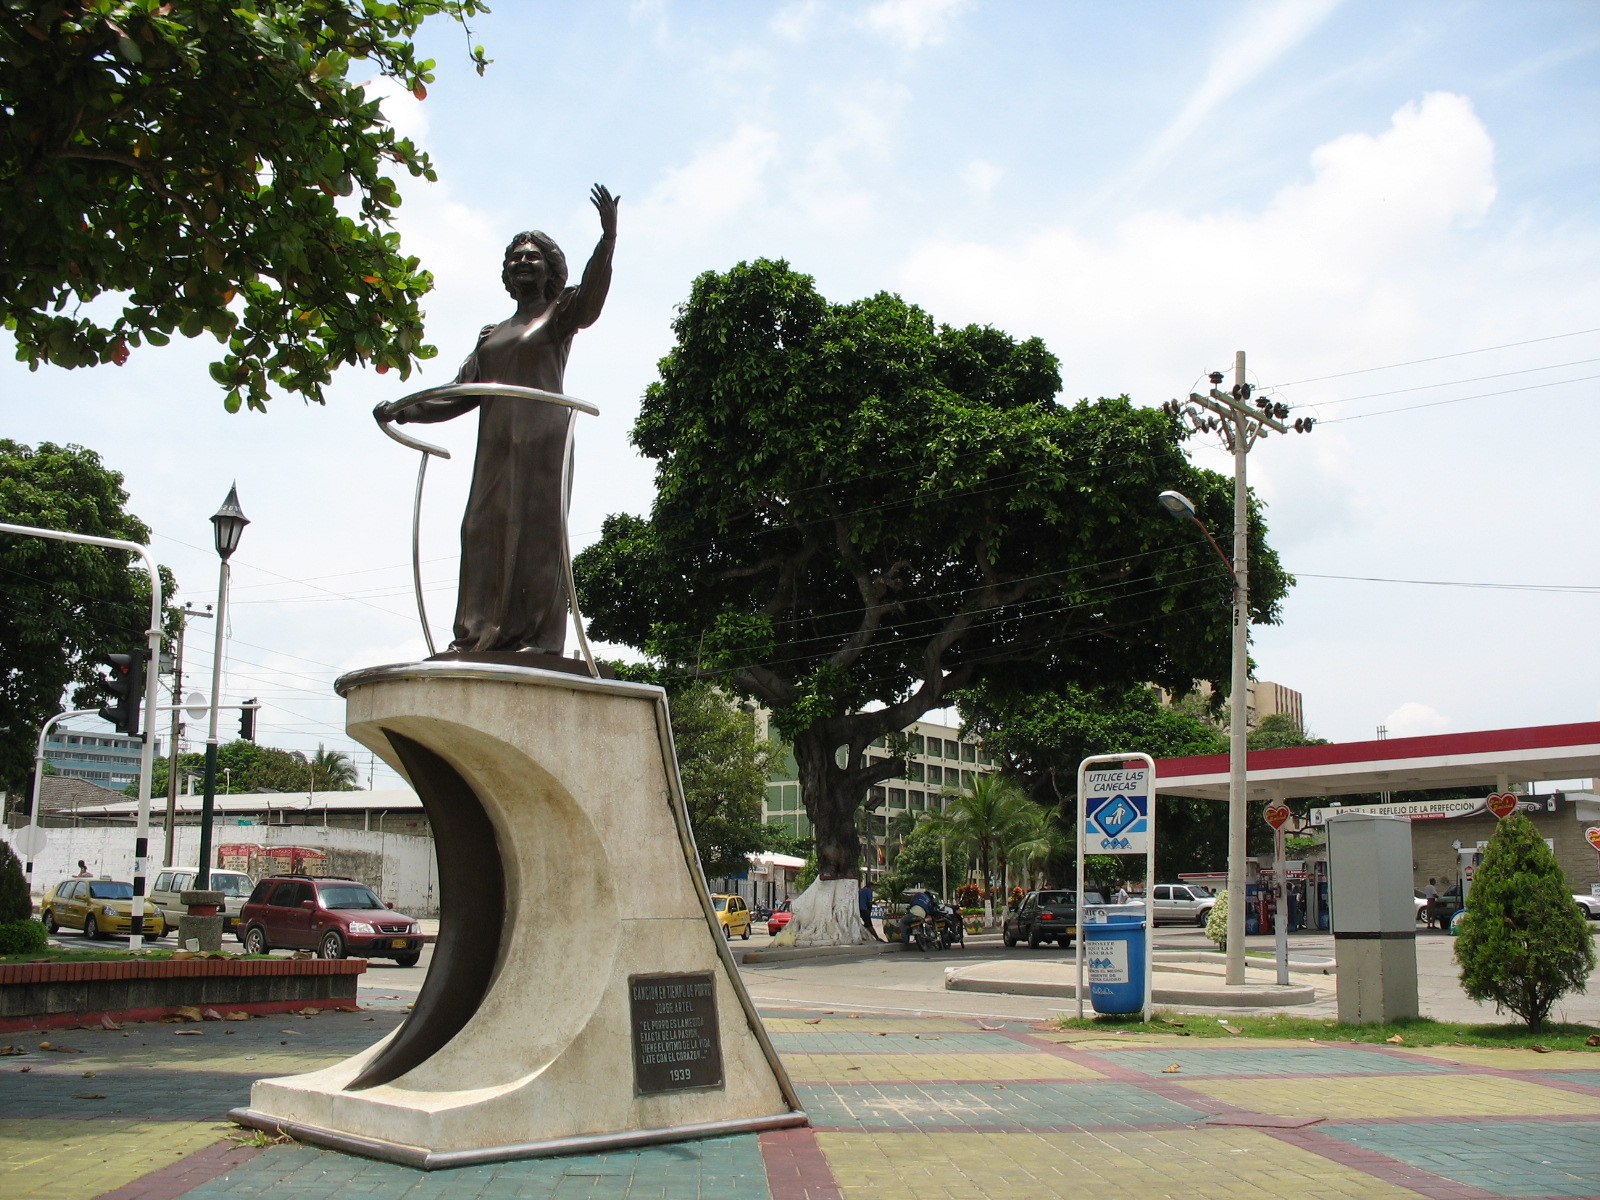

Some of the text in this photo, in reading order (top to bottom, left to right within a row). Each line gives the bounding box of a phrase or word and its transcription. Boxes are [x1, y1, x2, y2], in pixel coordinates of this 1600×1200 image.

[1089, 772, 1144, 782] UTILICE LAS
[1094, 782, 1137, 792] CANECAS
[1379, 806, 1407, 815] REFLEJO
[1408, 805, 1418, 814] DE
[1420, 805, 1428, 813] LA
[1430, 801, 1475, 813] PERFECCIÓN
[655, 1001, 694, 1014] JORGE ARTEL
[670, 1019, 677, 1029] ES
[640, 1031, 661, 1042] EXACTA
[662, 1030, 670, 1041] DE
[670, 1030, 677, 1040] LA
[641, 1042, 657, 1053] TIENE
[657, 1042, 665, 1053] EL
[682, 1040, 690, 1050] DE
[690, 1039, 698, 1049] LA
[642, 1054, 656, 1065] LATE
[656, 1053, 668, 1063] CON
[668, 1052, 675, 1062] EL
[670, 1068, 691, 1081] 1939
